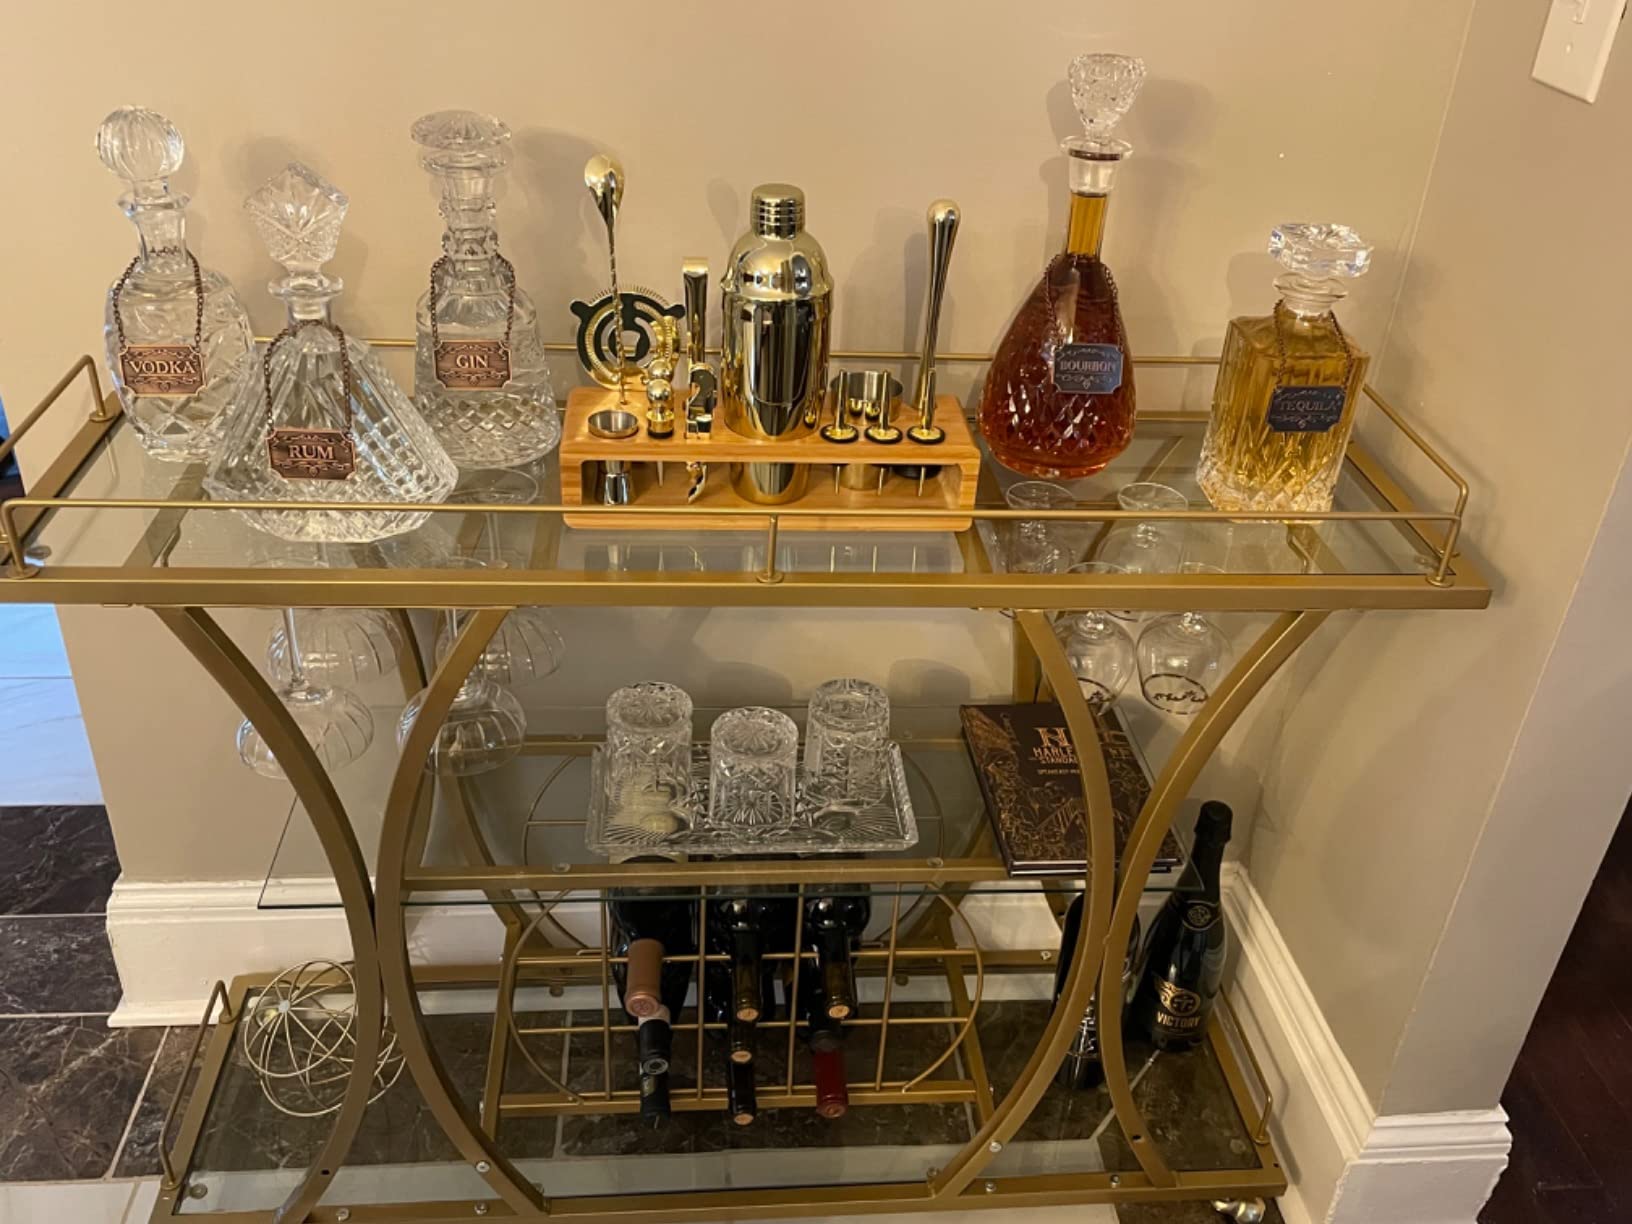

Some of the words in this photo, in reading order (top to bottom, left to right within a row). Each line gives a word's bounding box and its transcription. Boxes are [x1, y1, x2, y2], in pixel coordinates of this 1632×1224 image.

[129, 360, 196, 374] VODKA
[456, 355, 489, 369] GIN
[1060, 360, 1117, 372] BOURBON
[1280, 400, 1337, 412] TEQUILA
[289, 445, 334, 459] RUM
[1032, 747, 1074, 758] HARLE
[1156, 1011, 1201, 1028] VICTORY
